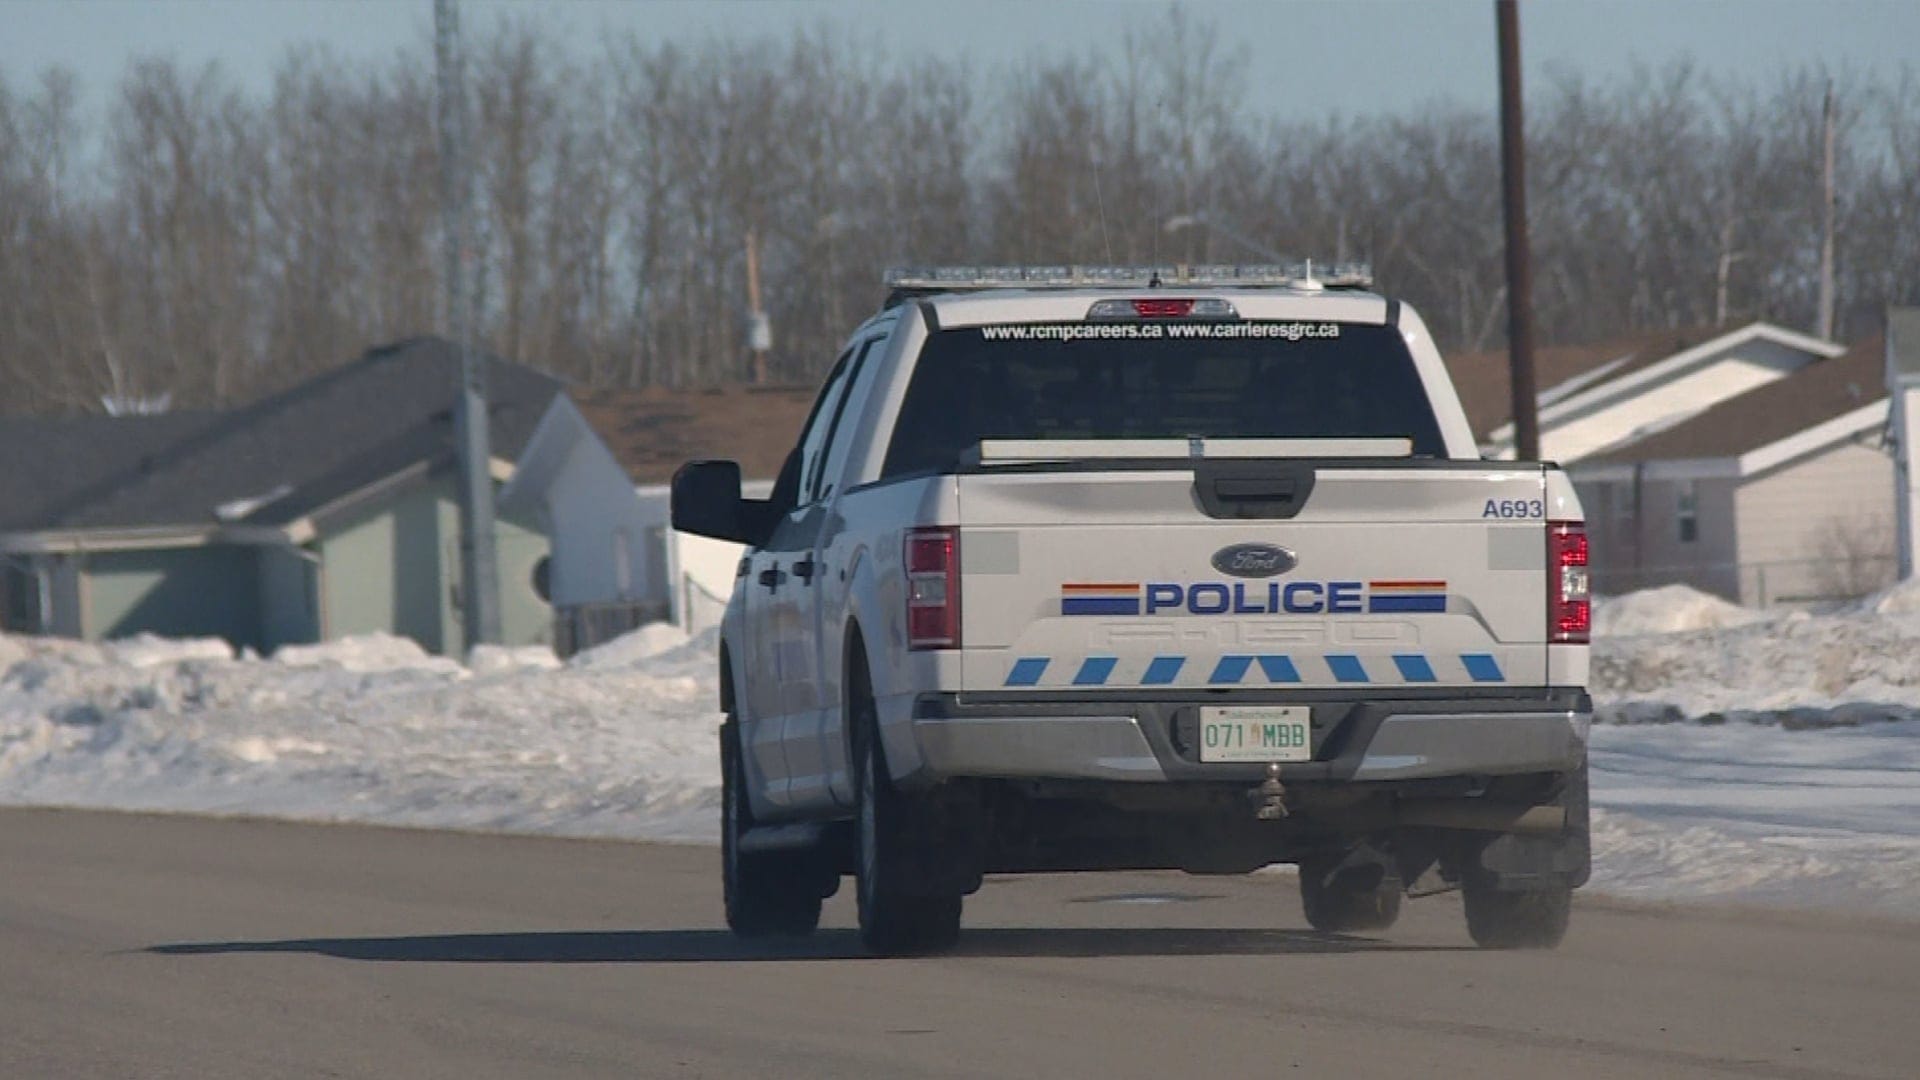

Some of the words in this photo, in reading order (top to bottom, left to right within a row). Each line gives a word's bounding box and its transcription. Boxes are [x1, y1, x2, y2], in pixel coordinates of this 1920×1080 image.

[982, 325, 1163, 342] www.rcmpcareers.ca
[1167, 322, 1339, 340] www.carrieresgrc.ca
[1483, 499, 1542, 518] A693
[1231, 551, 1279, 569] Ford
[1145, 581, 1363, 615] POLICE
[1089, 619, 1421, 647] F-150
[1205, 724, 1243, 748] 071
[1263, 724, 1305, 748] MBB
